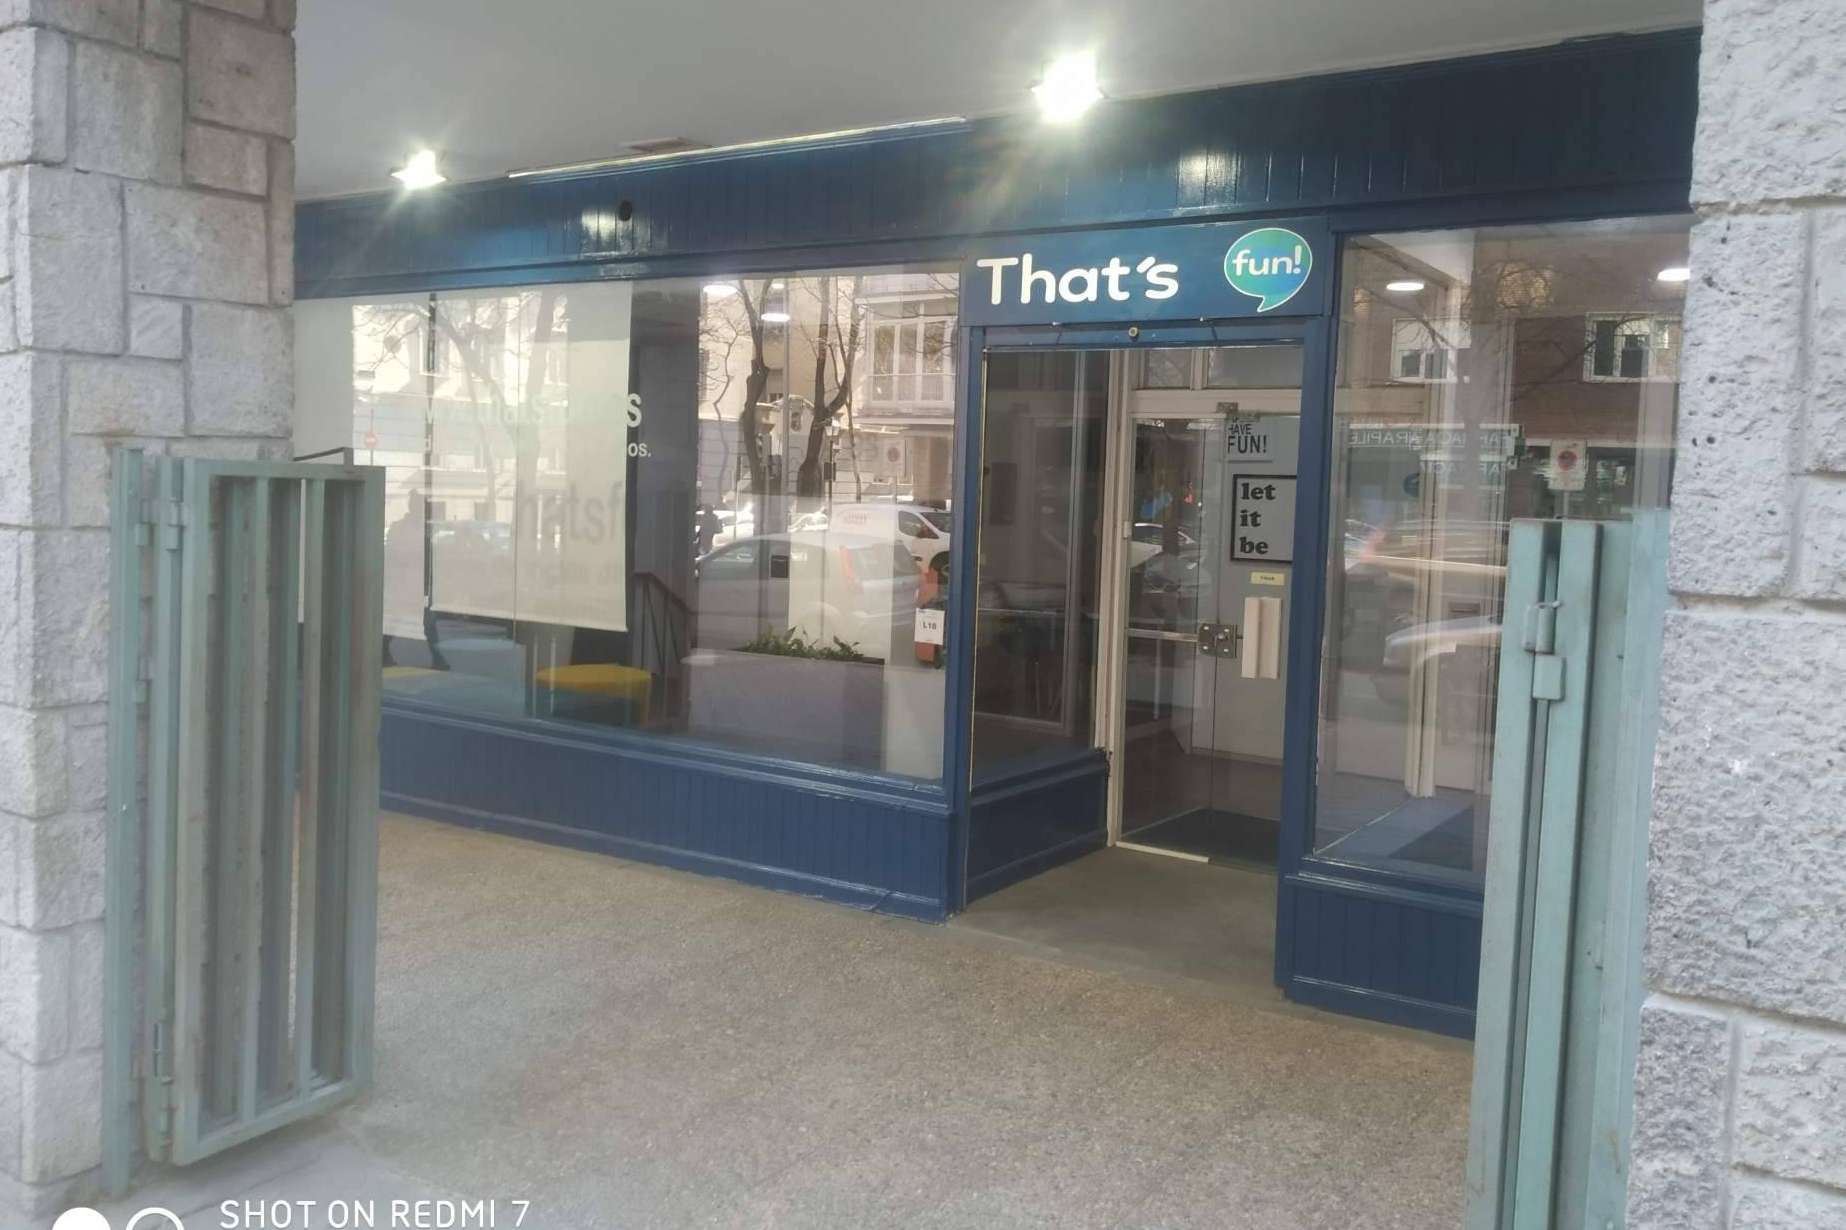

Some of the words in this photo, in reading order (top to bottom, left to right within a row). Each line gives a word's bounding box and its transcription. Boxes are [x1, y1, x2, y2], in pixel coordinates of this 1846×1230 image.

[975, 248, 1179, 306] That's
[1231, 245, 1304, 278] fun!
[1228, 435, 1267, 455] FUN!
[1240, 482, 1276, 501] let
[1239, 509, 1262, 528] it
[1239, 536, 1269, 555] be
